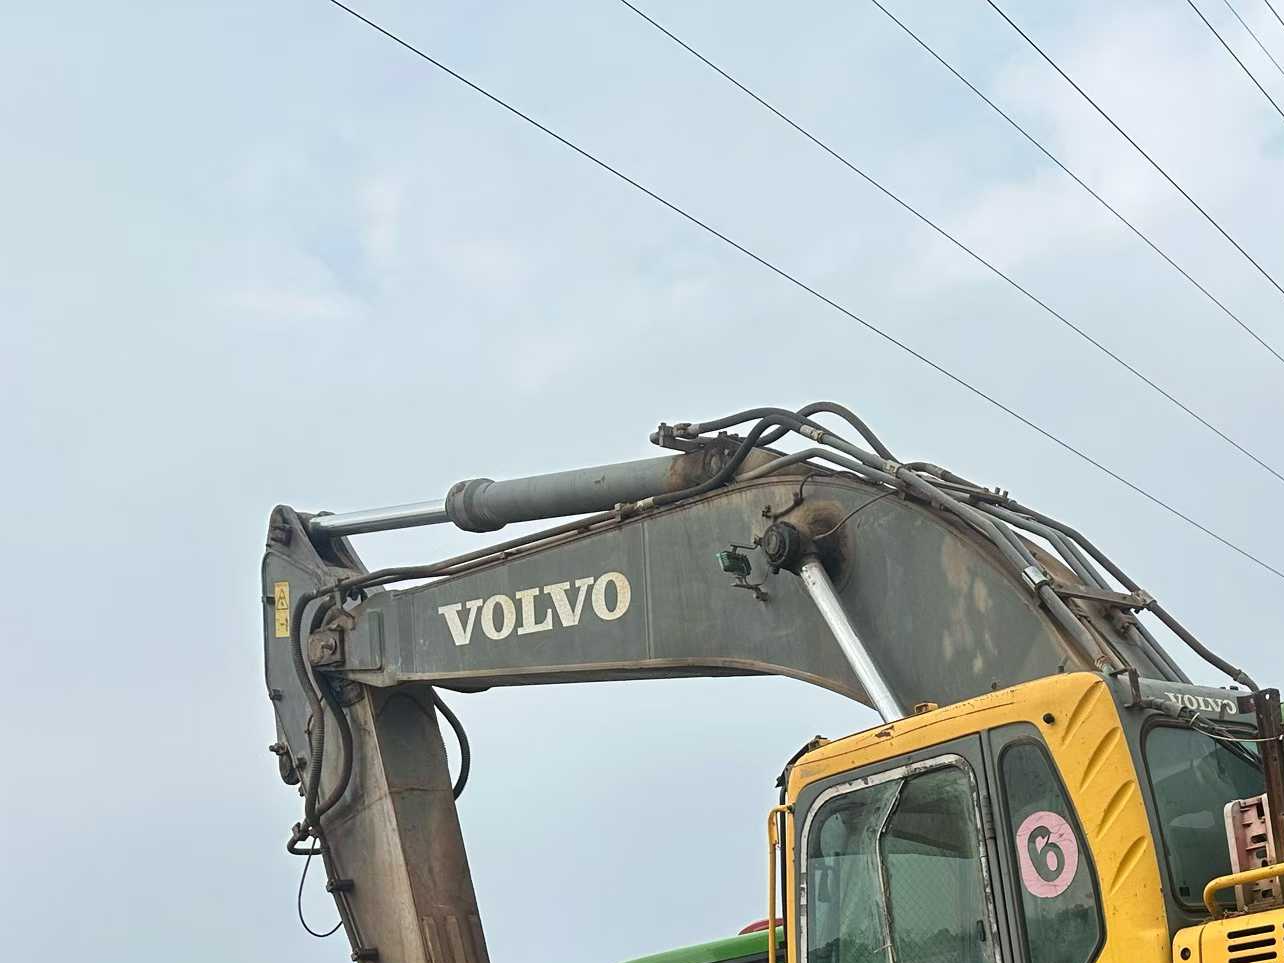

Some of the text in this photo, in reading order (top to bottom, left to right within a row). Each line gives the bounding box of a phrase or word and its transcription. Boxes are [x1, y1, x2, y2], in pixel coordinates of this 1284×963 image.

[438, 571, 632, 646] VOLVO
[1164, 692, 1237, 714] VOLVO
[1027, 825, 1066, 883] 6
